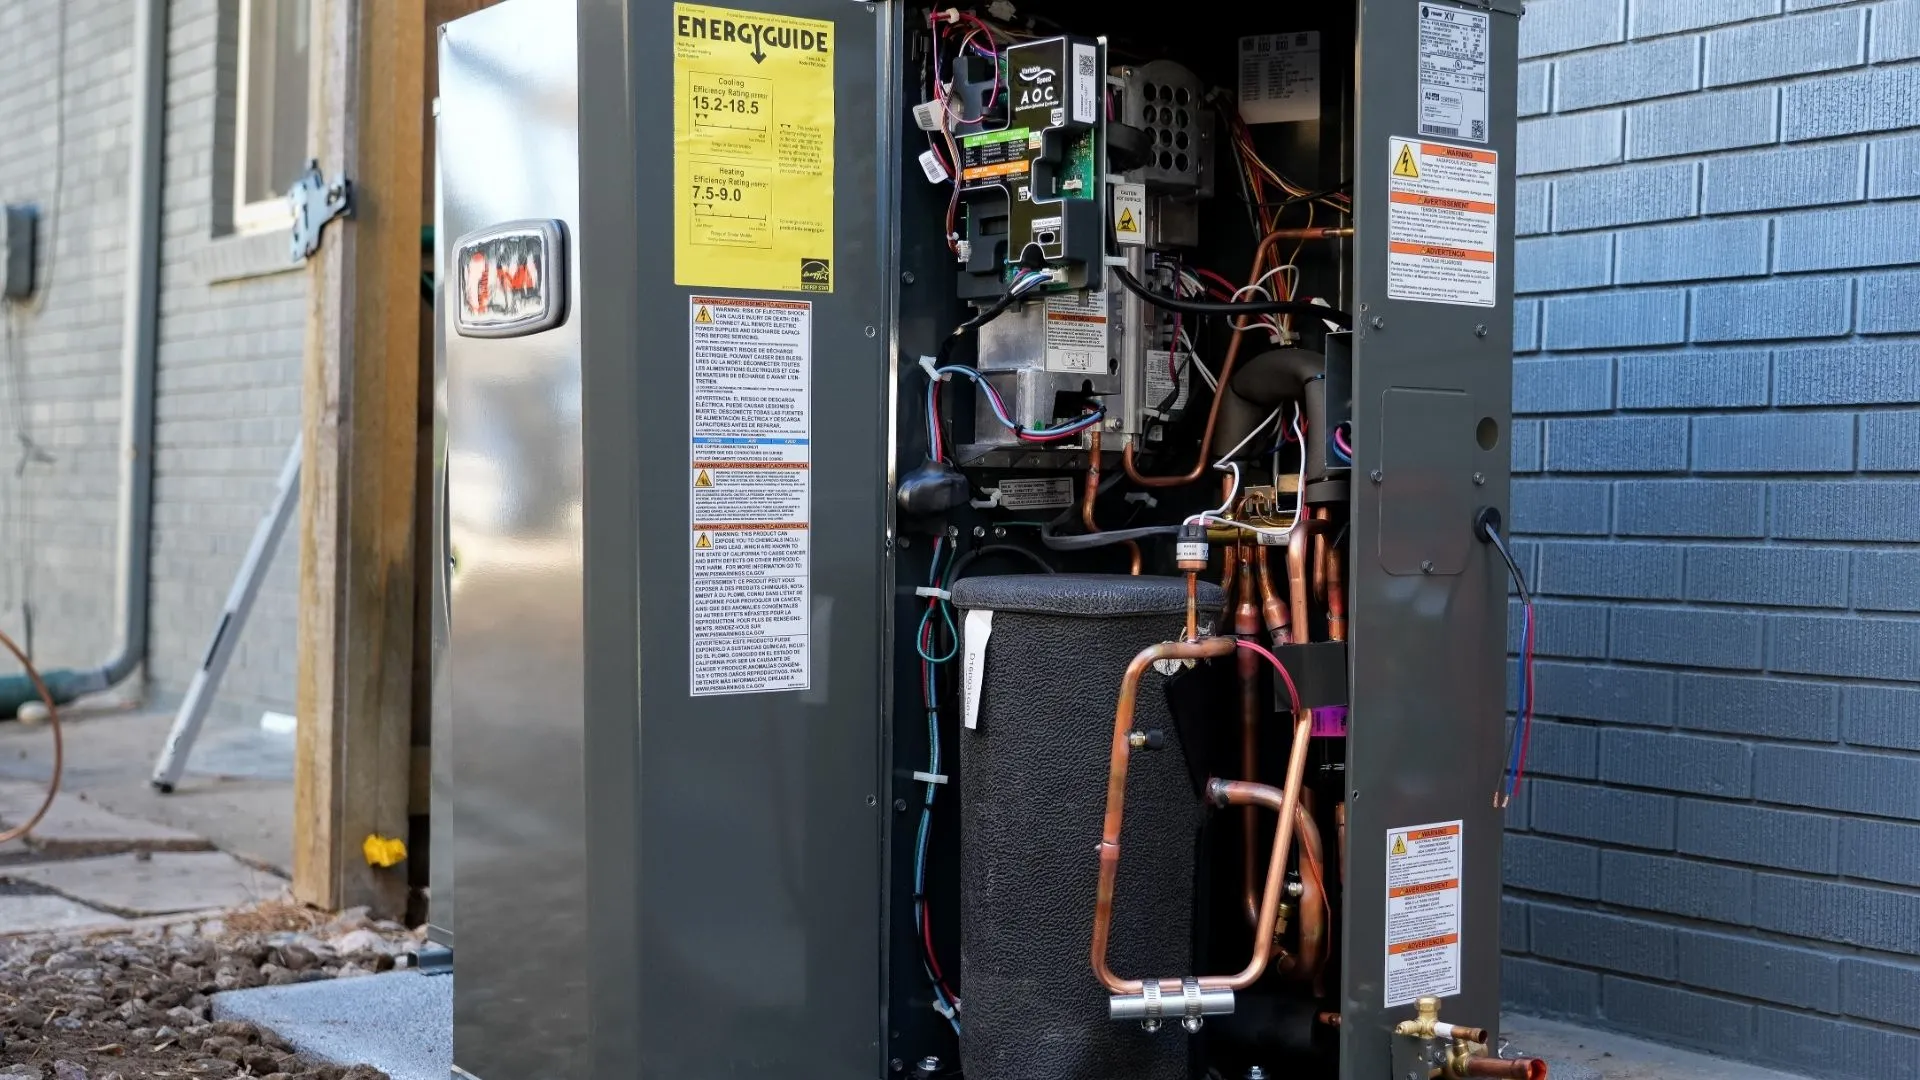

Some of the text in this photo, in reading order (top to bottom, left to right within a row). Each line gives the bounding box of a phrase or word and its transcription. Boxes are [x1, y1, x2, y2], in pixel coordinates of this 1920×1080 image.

[1444, 12, 1454, 21] XV
[678, 15, 827, 52] ENERGYGUIDE
[718, 77, 744, 88] Cooling
[1036, 75, 1052, 84] Speed
[693, 85, 749, 99] Efficiency Rating
[693, 96, 759, 114] 15.2-18.5
[1446, 149, 1473, 159] WARNING
[720, 167, 744, 177] Heating
[694, 176, 749, 188] Efficiency Rating
[692, 186, 742, 202] 7.5-9.0
[1423, 197, 1469, 208] AVERTISSEMENT
[1426, 247, 1466, 257] ADVERTENCIA
[1422, 828, 1447, 837] WARNING
[1405, 882, 1448, 892] AVERTISSEMENT
[1408, 938, 1444, 949] ADVERTENCIA
